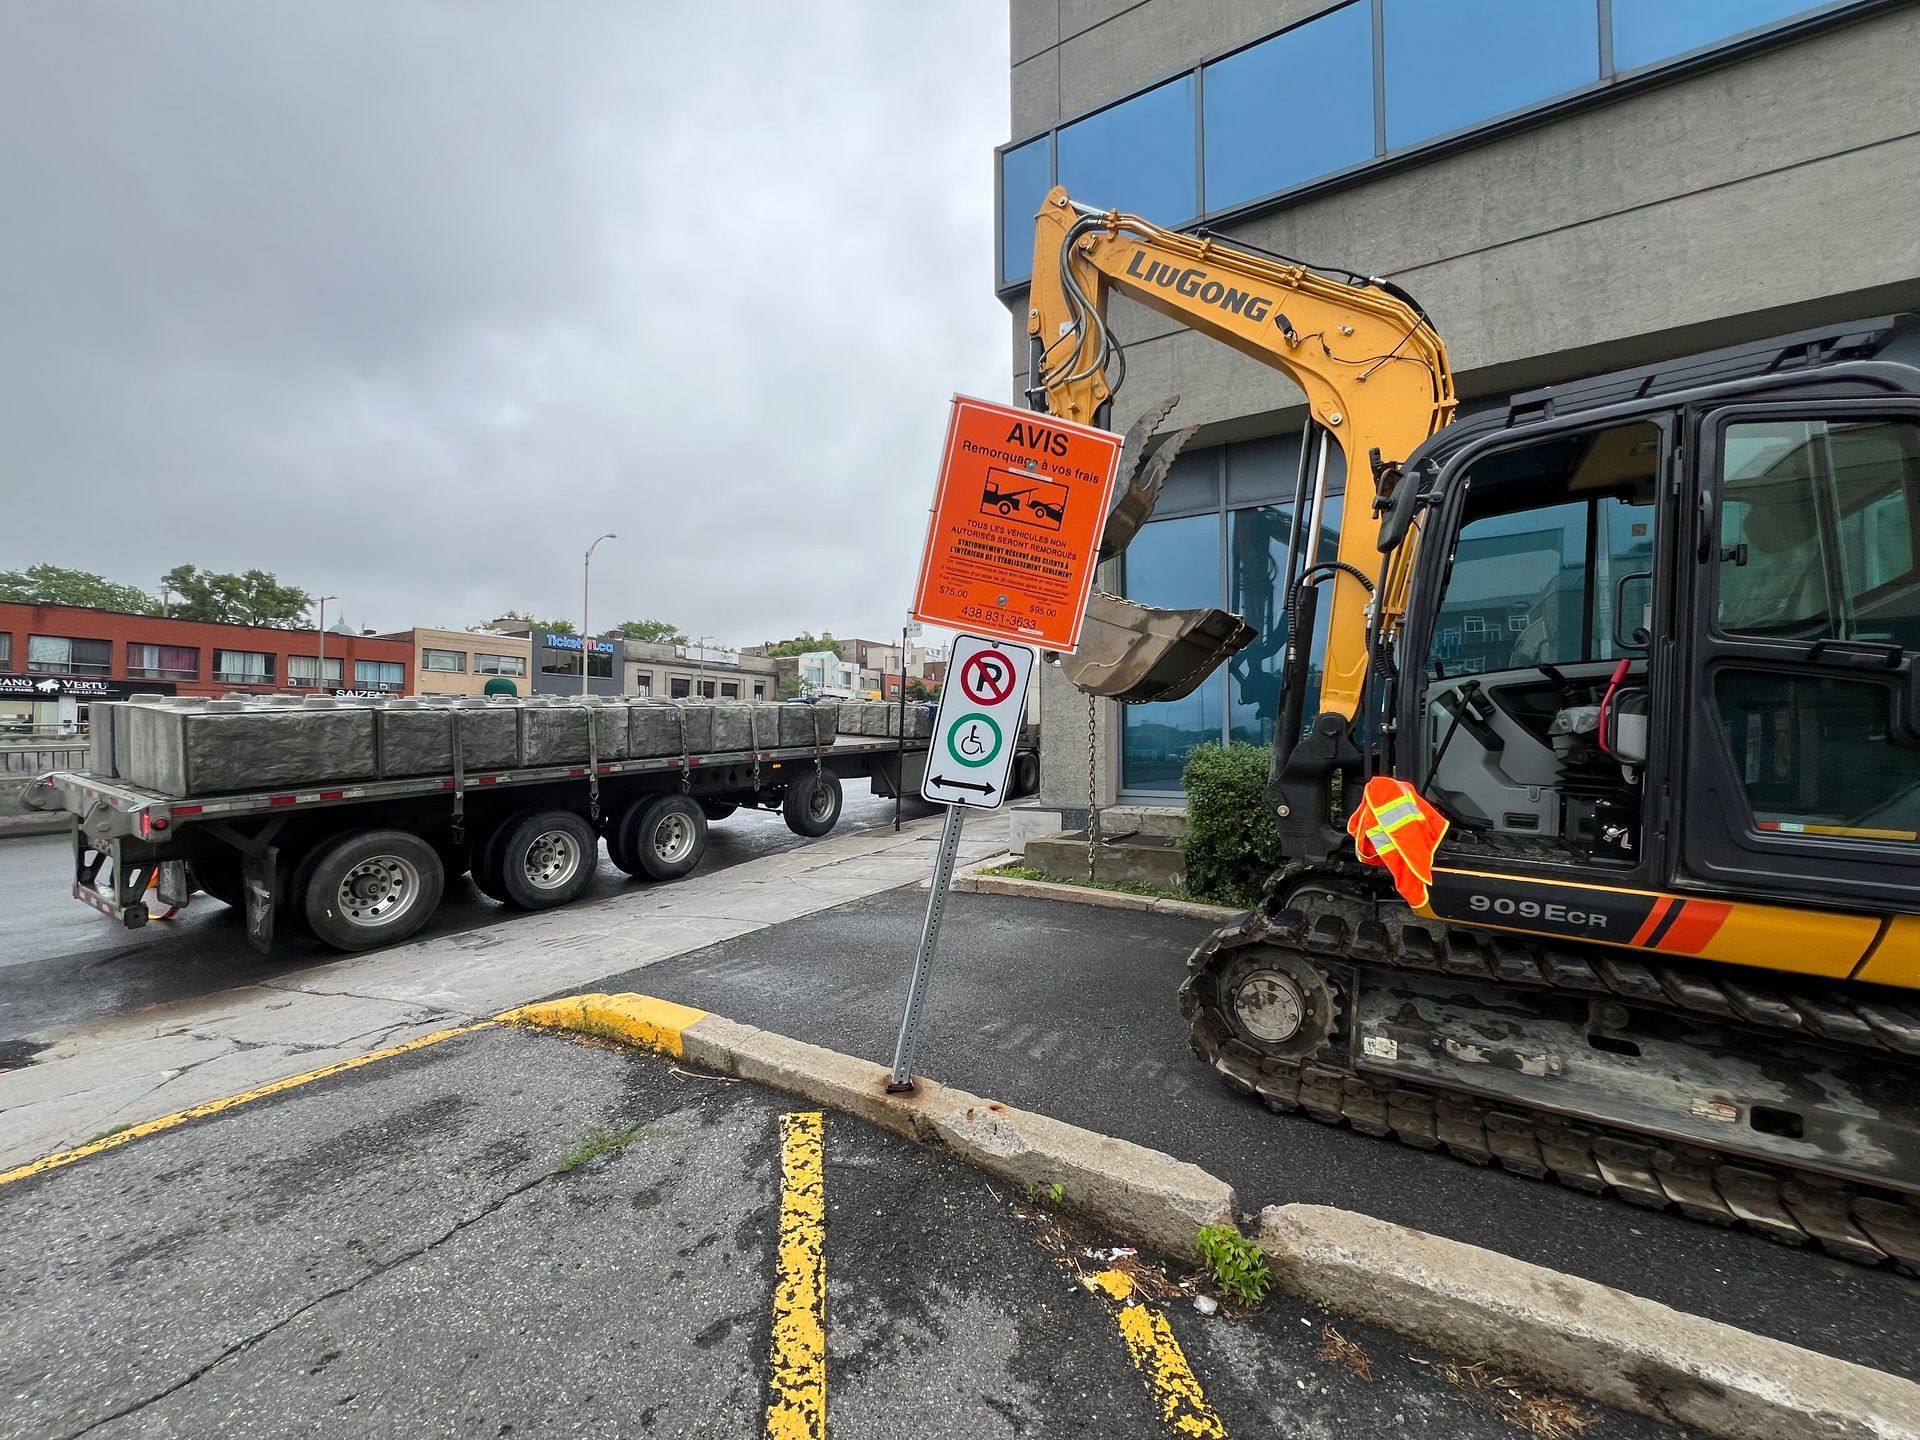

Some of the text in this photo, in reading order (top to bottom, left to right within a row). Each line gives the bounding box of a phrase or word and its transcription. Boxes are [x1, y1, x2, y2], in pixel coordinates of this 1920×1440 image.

[1006, 422, 1068, 456] AVIS
[1040, 458, 1048, 471] à
[1051, 464, 1072, 477] vos
[1075, 468, 1099, 484] frais
[951, 526, 1076, 560] AUTORISÉS SERONT REMORQUÉS
[967, 519, 1066, 547] TOUS LES VÉHICULES NON
[958, 538, 1004, 554] STATIONNEMENT
[1029, 554, 1041, 562] AUX
[1042, 557, 1063, 568] CLIENTS
[1042, 566, 1072, 578] SEULEMENT
[939, 585, 967, 598] $75.00
[961, 606, 982, 618] 438
[985, 611, 1036, 629] 831-3633
[1029, 604, 1056, 617] $95.00
